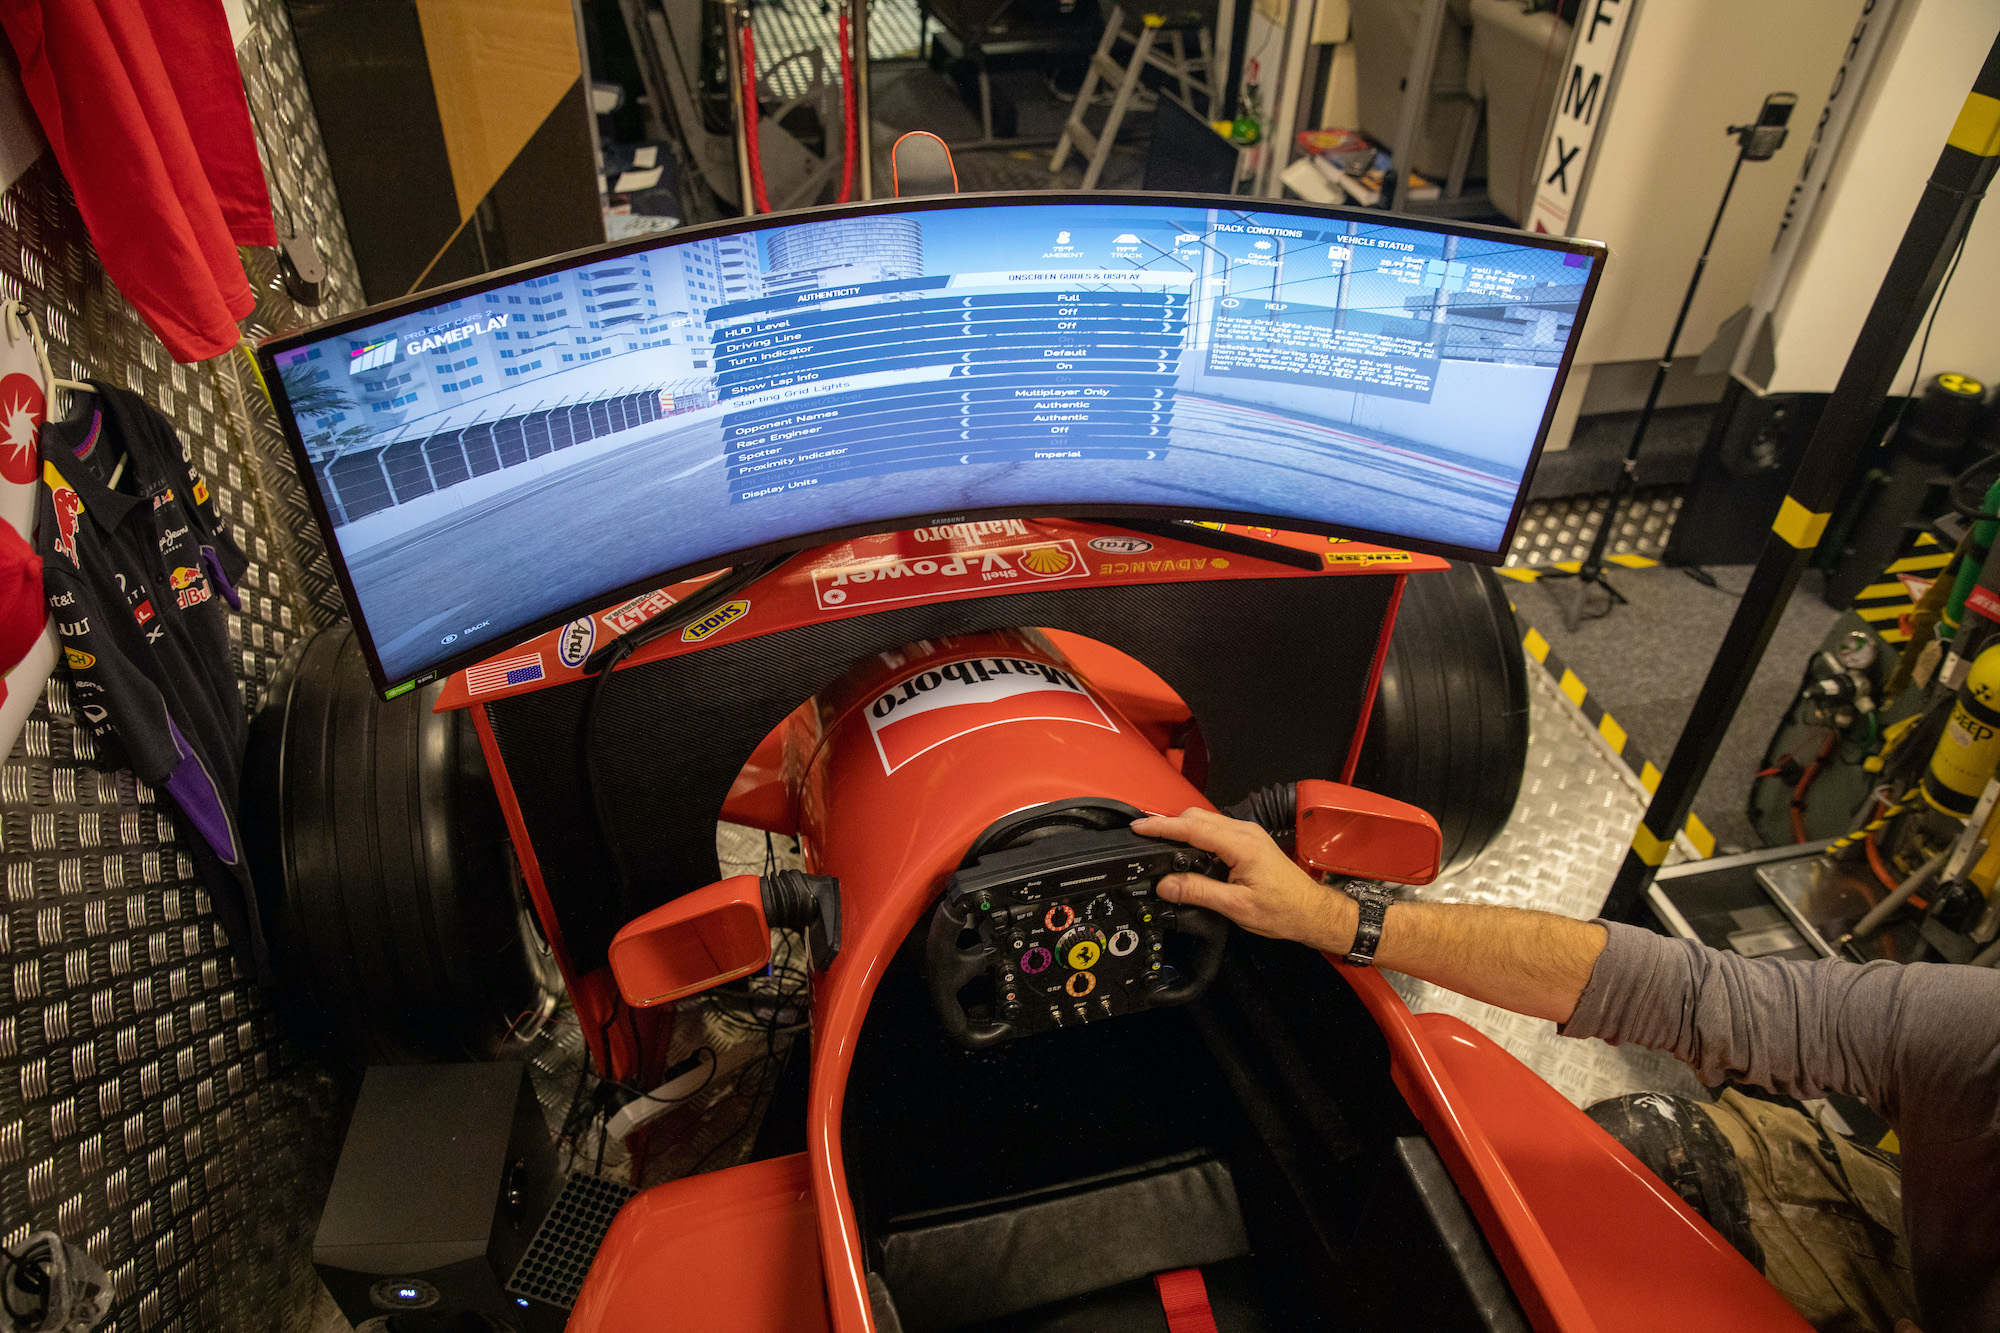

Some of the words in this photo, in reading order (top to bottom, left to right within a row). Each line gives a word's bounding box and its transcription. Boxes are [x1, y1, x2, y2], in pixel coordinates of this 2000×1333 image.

[1213, 224, 1244, 233] TRACK
[1247, 226, 1303, 238] CONDITIONS
[1337, 235, 1375, 246] VEHICLE
[1378, 239, 1414, 251] STATUS
[1234, 258, 1284, 267] FORECAST
[797, 287, 860, 302] AUTHENTICITY
[1264, 303, 1287, 311] HELP
[403, 322, 451, 341] PROJECT
[455, 312, 483, 325] CARS
[406, 314, 509, 355] GAMEPLAY
[725, 327, 752, 338] HUD
[757, 320, 790, 332] Level
[1218, 316, 1252, 324] Starting
[1276, 321, 1301, 329] Lights
[1348, 331, 1393, 341] on-screen
[1396, 337, 1422, 345] image
[727, 338, 770, 352] Driving
[775, 333, 802, 343] Line
[1269, 326, 1291, 334] lights
[1380, 341, 1416, 351] allowing
[1317, 337, 1339, 345] lights
[1394, 349, 1420, 357] trying
[729, 356, 757, 366] Turn
[761, 346, 814, 360] Indicator
[1044, 349, 1087, 357] Default
[1213, 343, 1254, 352] Switching
[1273, 349, 1307, 357] Starting
[1331, 355, 1356, 363] Lights
[1393, 365, 1417, 373] allow
[731, 382, 766, 395] Show
[771, 376, 793, 387] Lap
[797, 372, 819, 382] Info
[1015, 389, 1080, 397] Multiplayer
[733, 394, 780, 408] Starting
[784, 388, 809, 398] Grid
[814, 382, 850, 392] Lights
[734, 408, 779, 422] Cockpit
[735, 418, 792, 435] Opponent
[796, 410, 839, 422] Names
[737, 437, 765, 448] Race
[770, 427, 822, 442] Engineer
[738, 448, 782, 462] Spotter
[739, 457, 795, 475] Proximity
[798, 448, 848, 462] Indicator
[1035, 451, 1081, 459] Imperial
[742, 485, 785, 500] Display
[788, 478, 818, 489] Units
[932, 516, 965, 525] SAMSUNG
[913, 519, 1029, 546] Marlboro
[1099, 541, 1145, 551] Arai
[830, 553, 1013, 587] V-Power
[982, 569, 1018, 581] Shell
[1100, 558, 1207, 575] ADVANCE
[464, 620, 491, 635] BACK
[689, 604, 742, 637] SHOEI
[568, 618, 591, 660] Arai
[871, 658, 1085, 718] Marlboro
